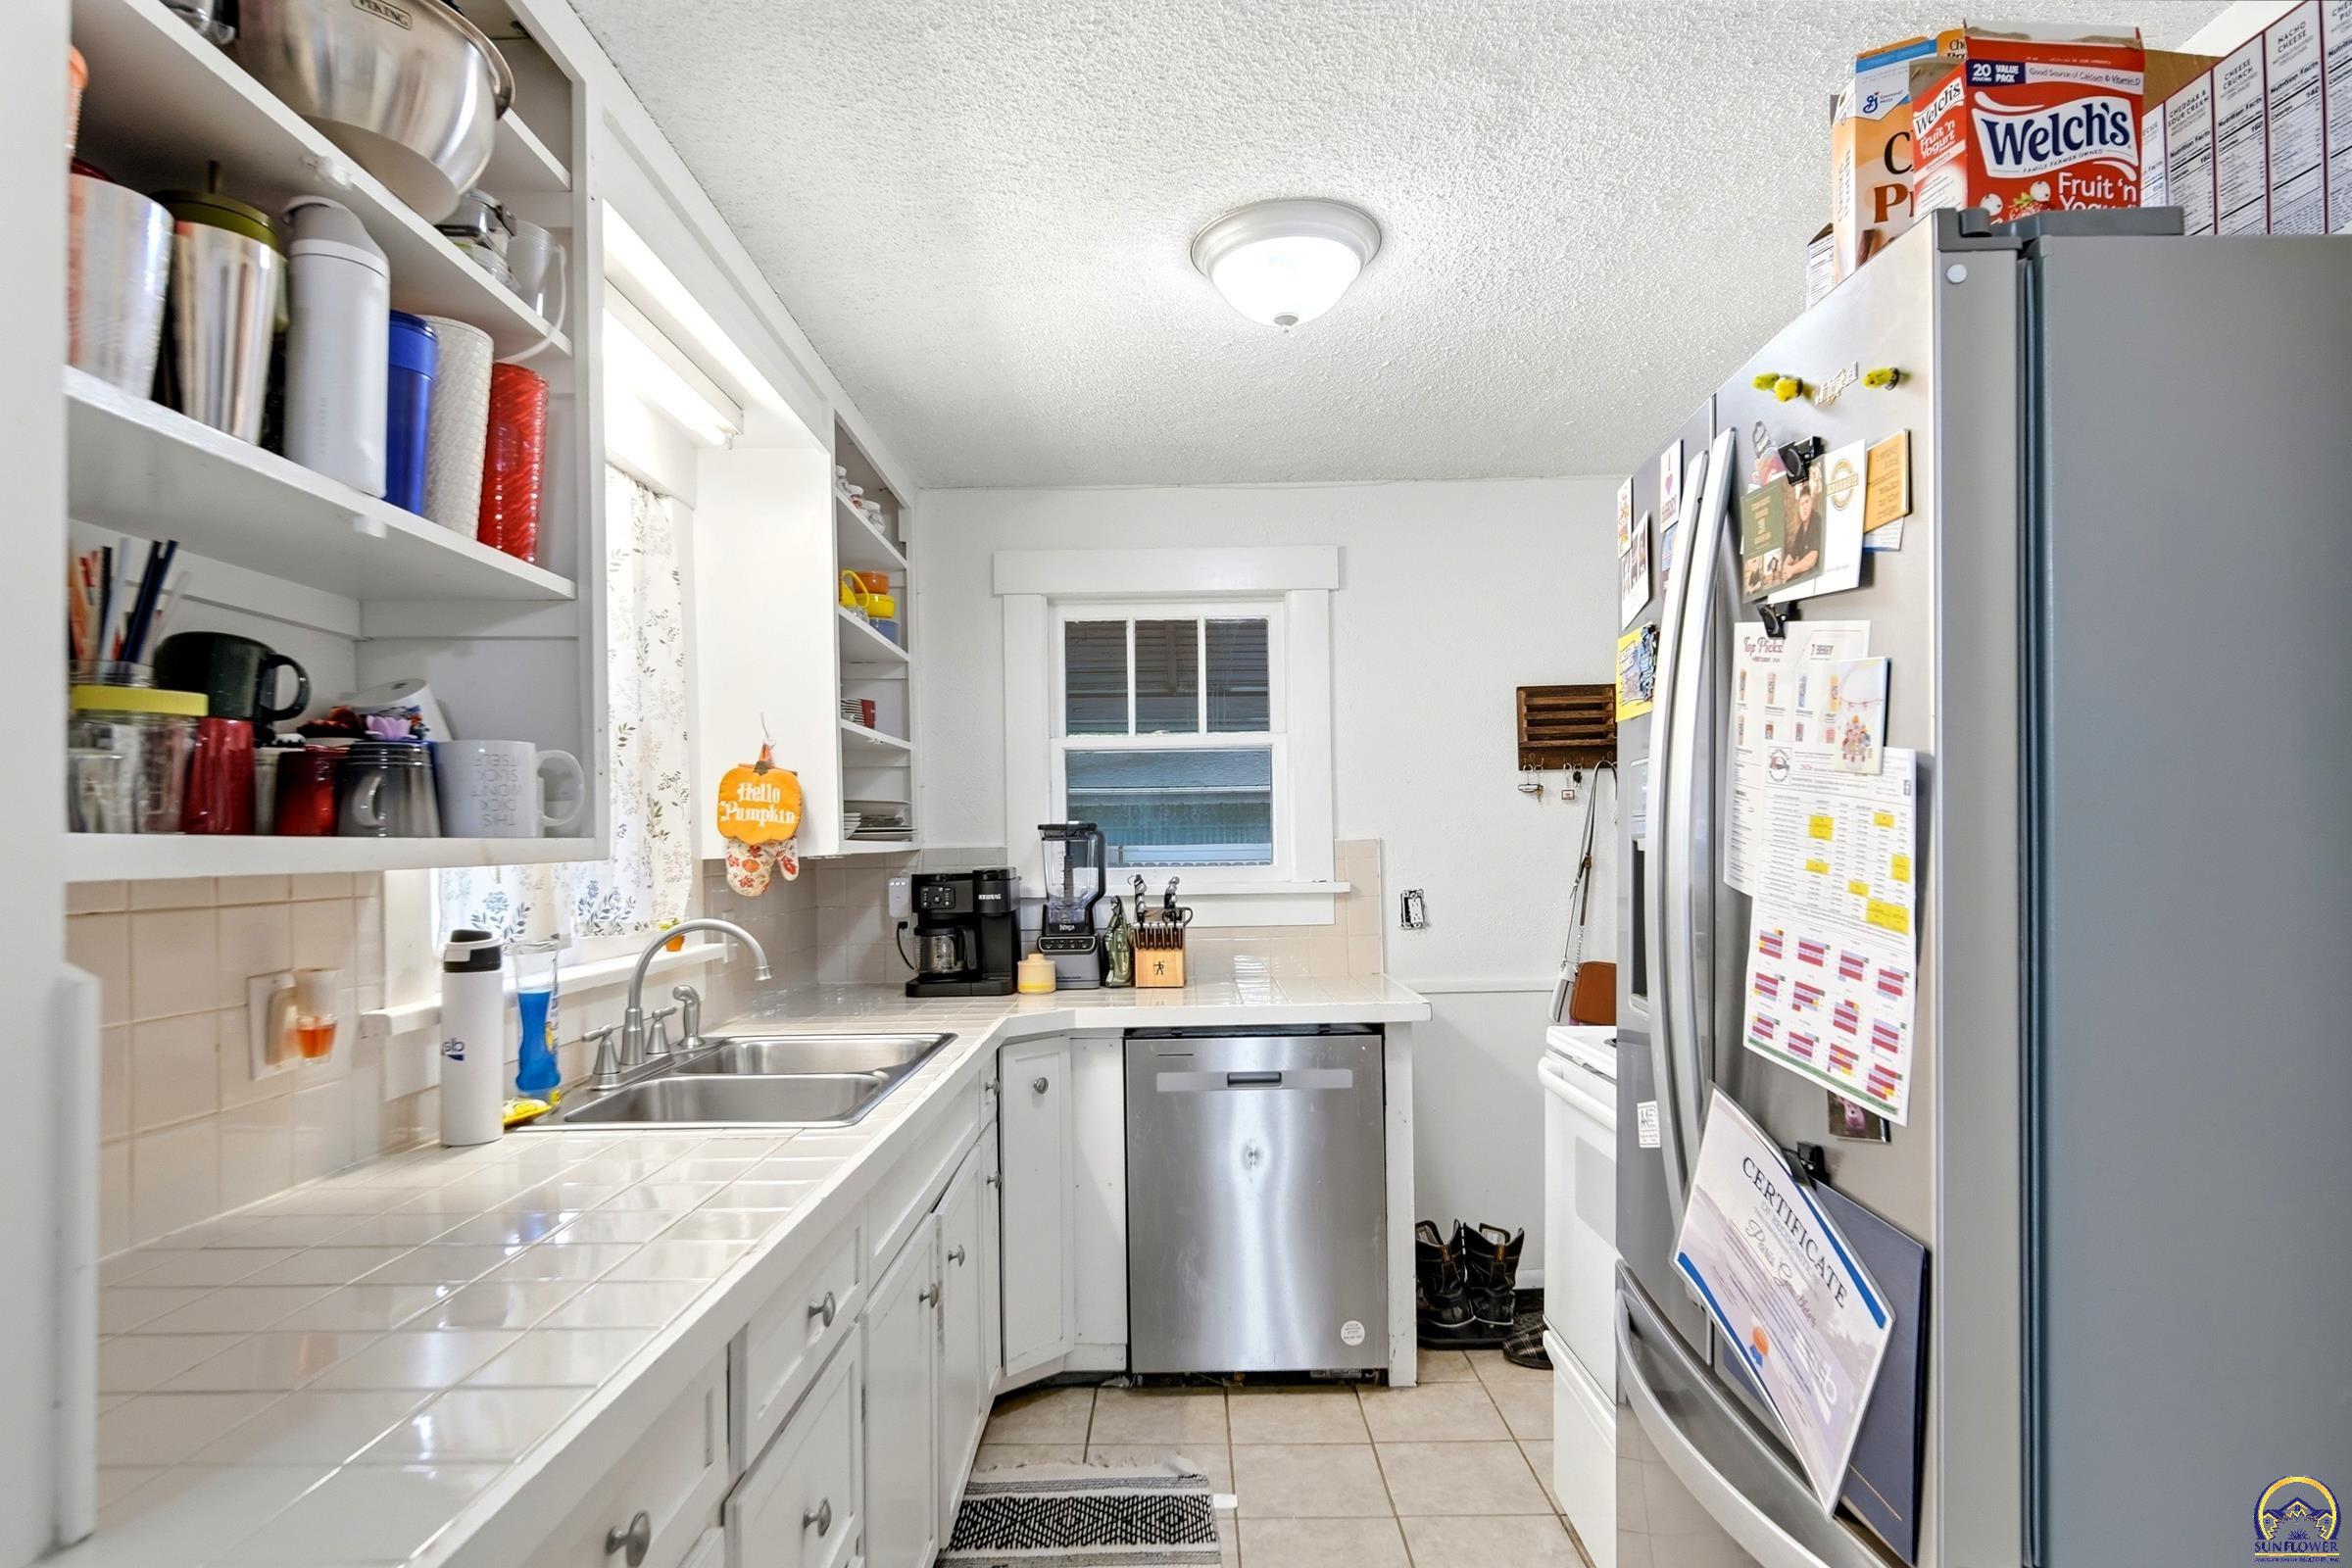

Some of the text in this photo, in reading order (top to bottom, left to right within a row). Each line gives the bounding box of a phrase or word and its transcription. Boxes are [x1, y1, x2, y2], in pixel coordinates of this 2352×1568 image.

[2278, 21, 2306, 44] NACHO
[2278, 30, 2307, 53] CHEESE
[1973, 63, 2019, 77] 20 VALUE
[1995, 74, 2016, 83] PACK
[2029, 67, 2048, 76] Good
[2048, 69, 2071, 78] Source
[2224, 58, 2251, 80] CHEESE
[1915, 81, 1961, 134] Welch's
[2168, 112, 2184, 127] SOUR
[2186, 97, 2209, 115] CREAM
[2169, 93, 2200, 118] CHEDDAR
[1921, 124, 1944, 149] Fruit
[1921, 130, 1956, 160] Yogurt
[1981, 102, 2130, 166] Welch's
[2023, 148, 2103, 173] FAMILY FARMER OWNED
[2059, 172, 2115, 200] Fruit
[737, 782, 781, 804] Hello
[718, 801, 796, 828] Pumpkin
[1742, 1156, 1847, 1309] CERTIFICATE
